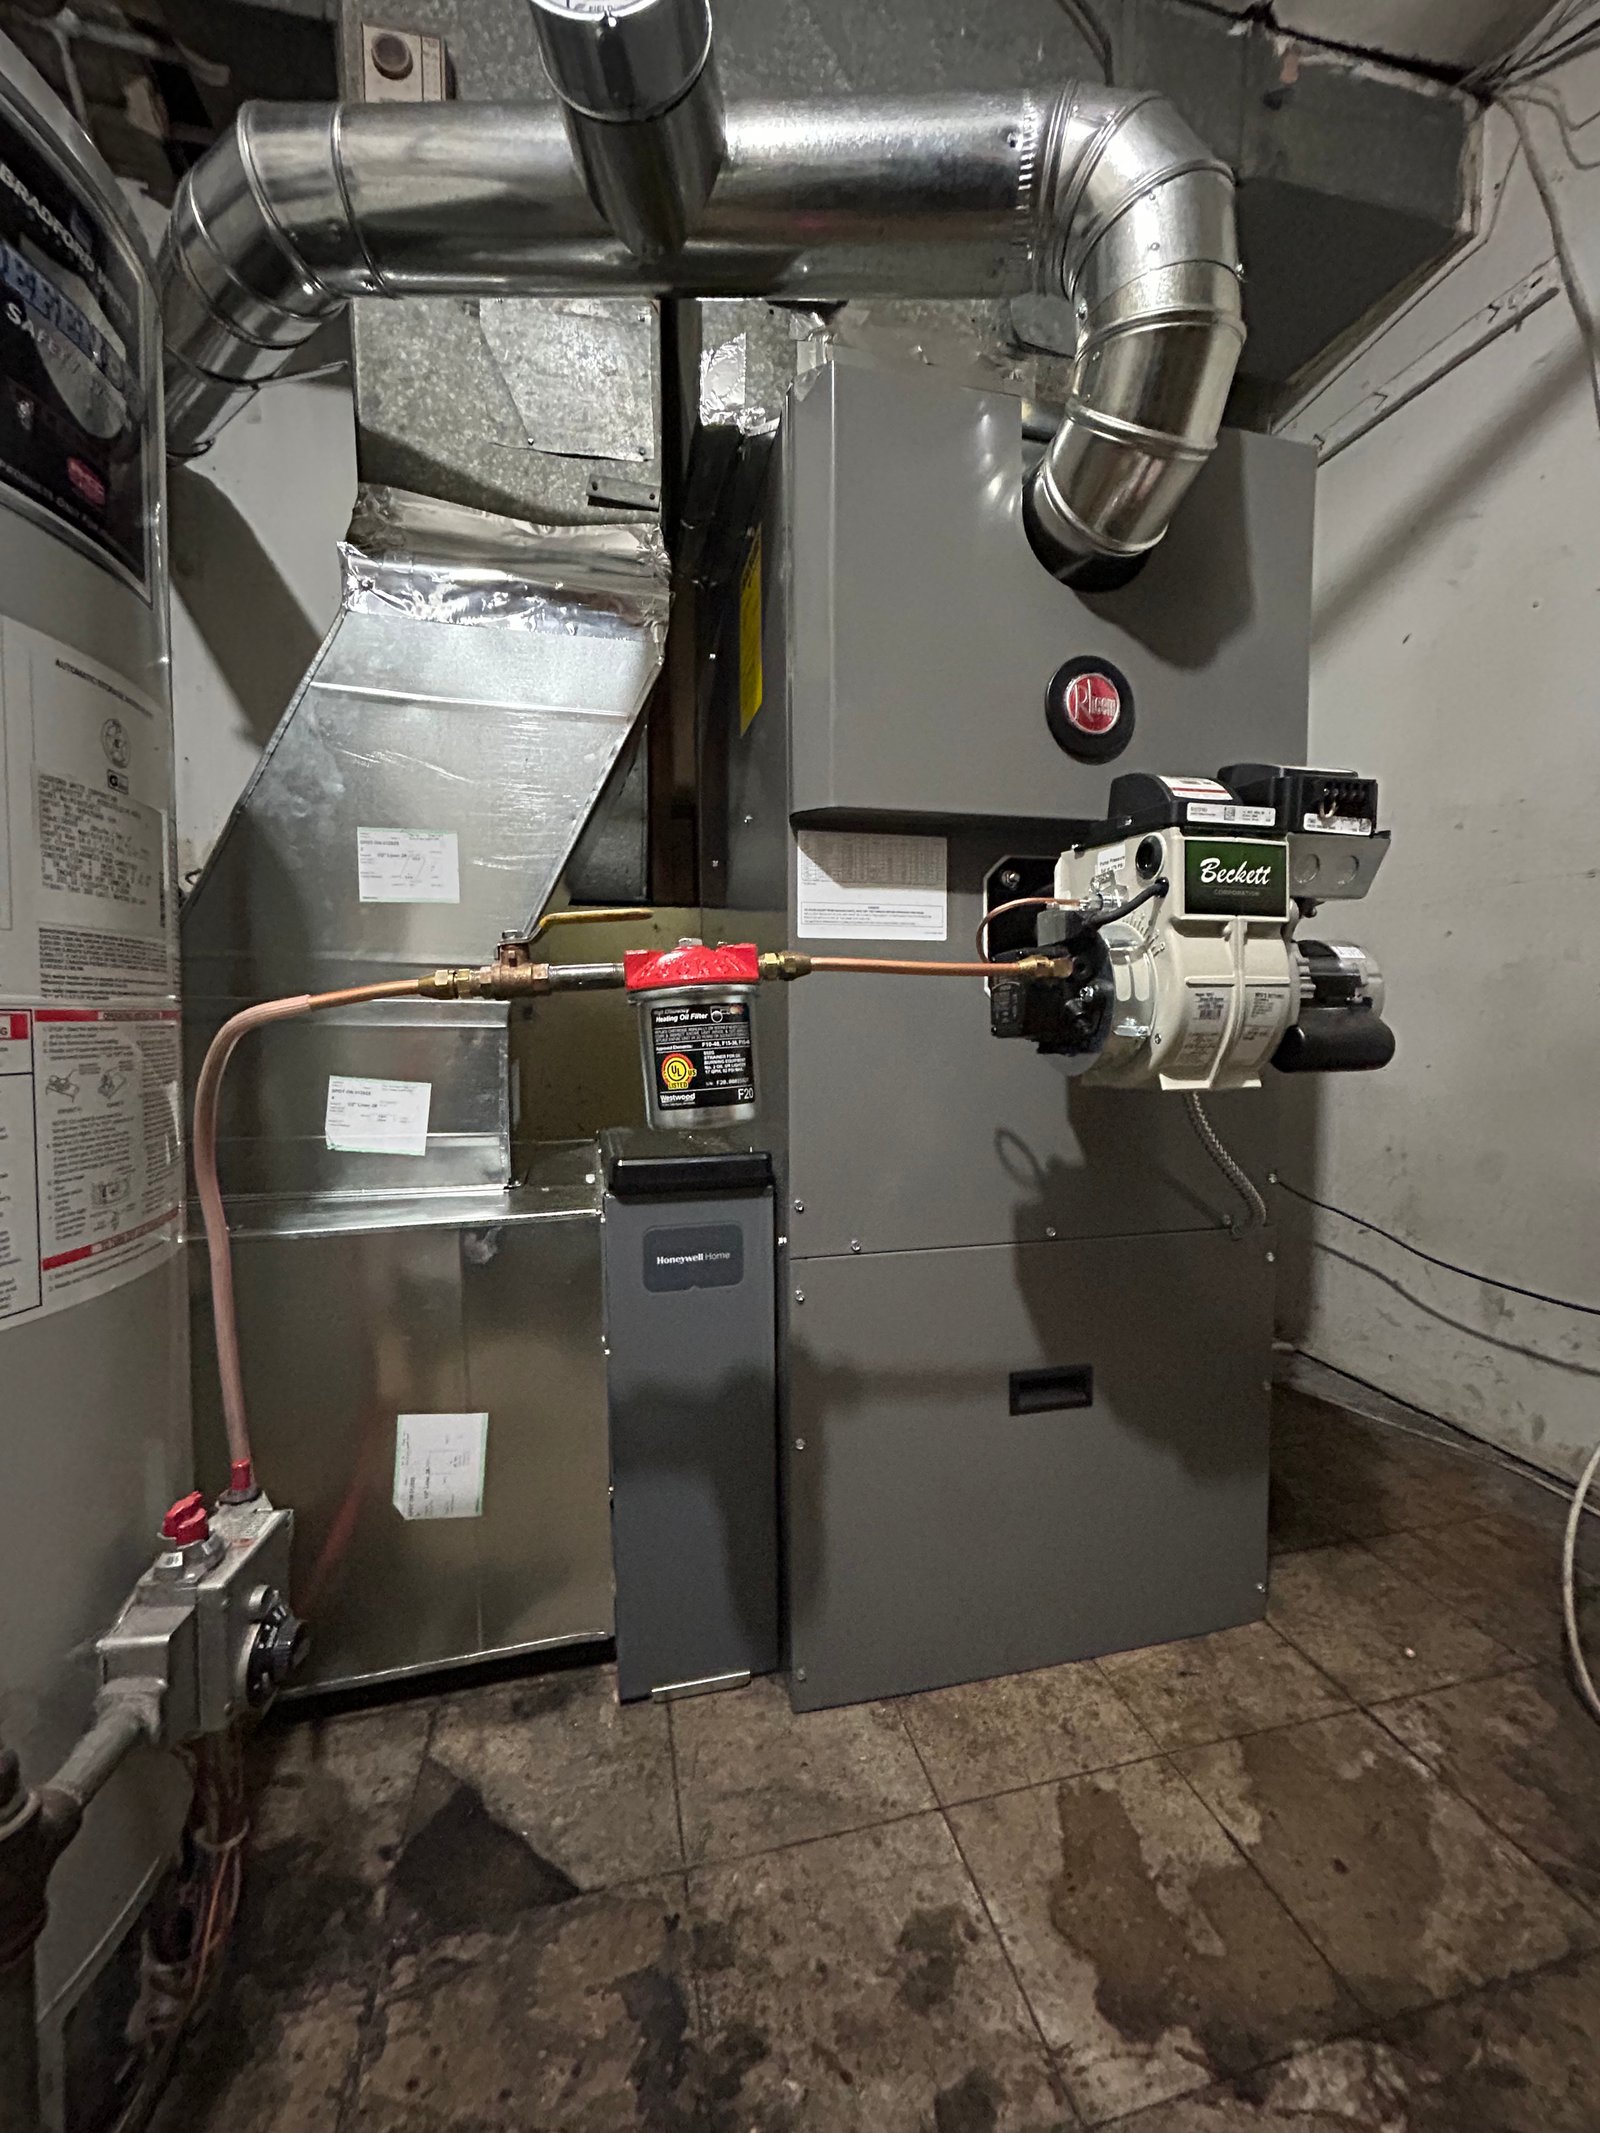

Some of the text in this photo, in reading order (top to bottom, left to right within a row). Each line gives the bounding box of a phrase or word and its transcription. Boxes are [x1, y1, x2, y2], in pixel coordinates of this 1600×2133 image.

[0, 162, 95, 272] BRADFORD
[1071, 678, 1116, 722] Rheem
[1200, 857, 1271, 885] Beckett
[655, 1011, 708, 1023] Heating Oil Filter
[671, 1065, 682, 1077] UL
[668, 1081, 688, 1089] LISTED
[660, 1092, 696, 1103] Westwood
[737, 1087, 754, 1100] F20
[656, 1252, 731, 1265] Honeywell Home
